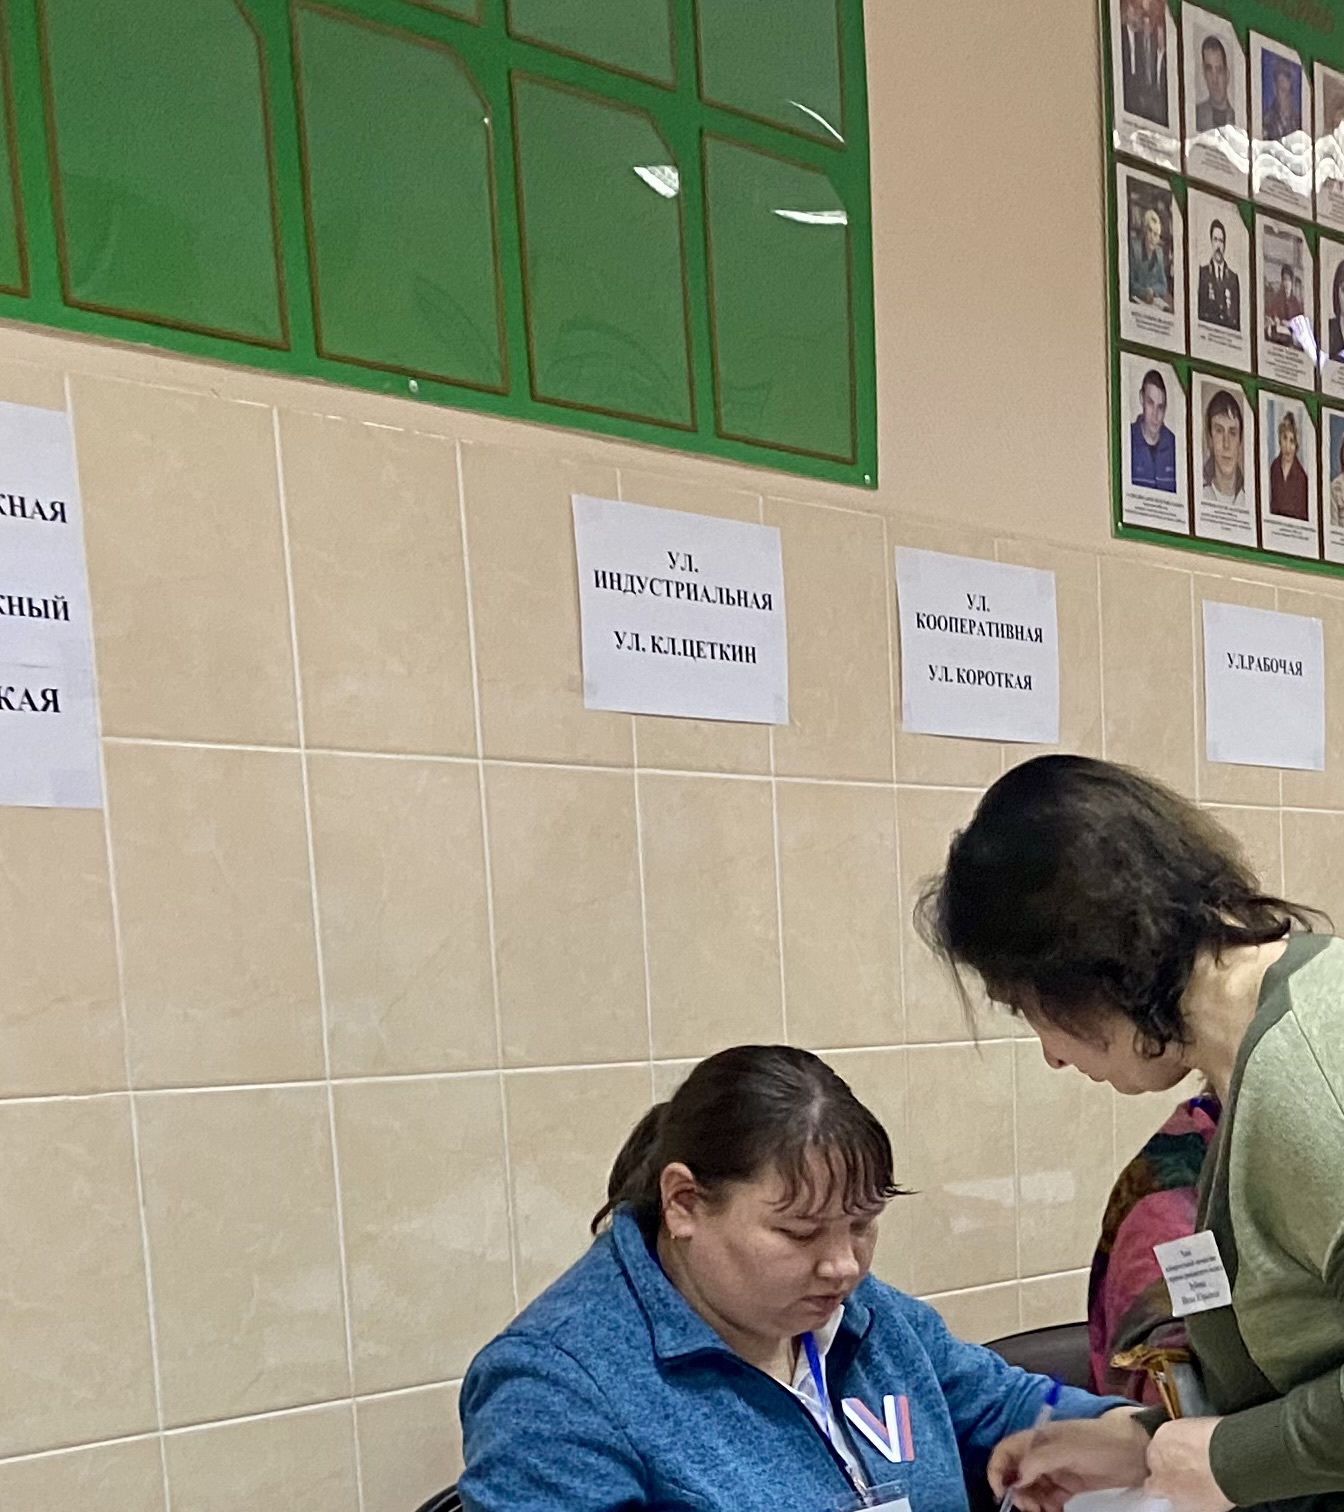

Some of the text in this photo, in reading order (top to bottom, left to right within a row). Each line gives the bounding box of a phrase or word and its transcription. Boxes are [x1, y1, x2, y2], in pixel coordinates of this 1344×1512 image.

[666, 551, 699, 573] УЛ.
[593, 569, 774, 611] ИНДУСТРИАЛЬНАЯ
[966, 592, 990, 612] УЛ.
[915, 612, 1043, 643] КООПЕРАТИВНАЯ
[613, 630, 757, 664] УЛ. КЛ.ЦЕТКИН
[928, 664, 1033, 691] УЛ. КОРОТКАЯ
